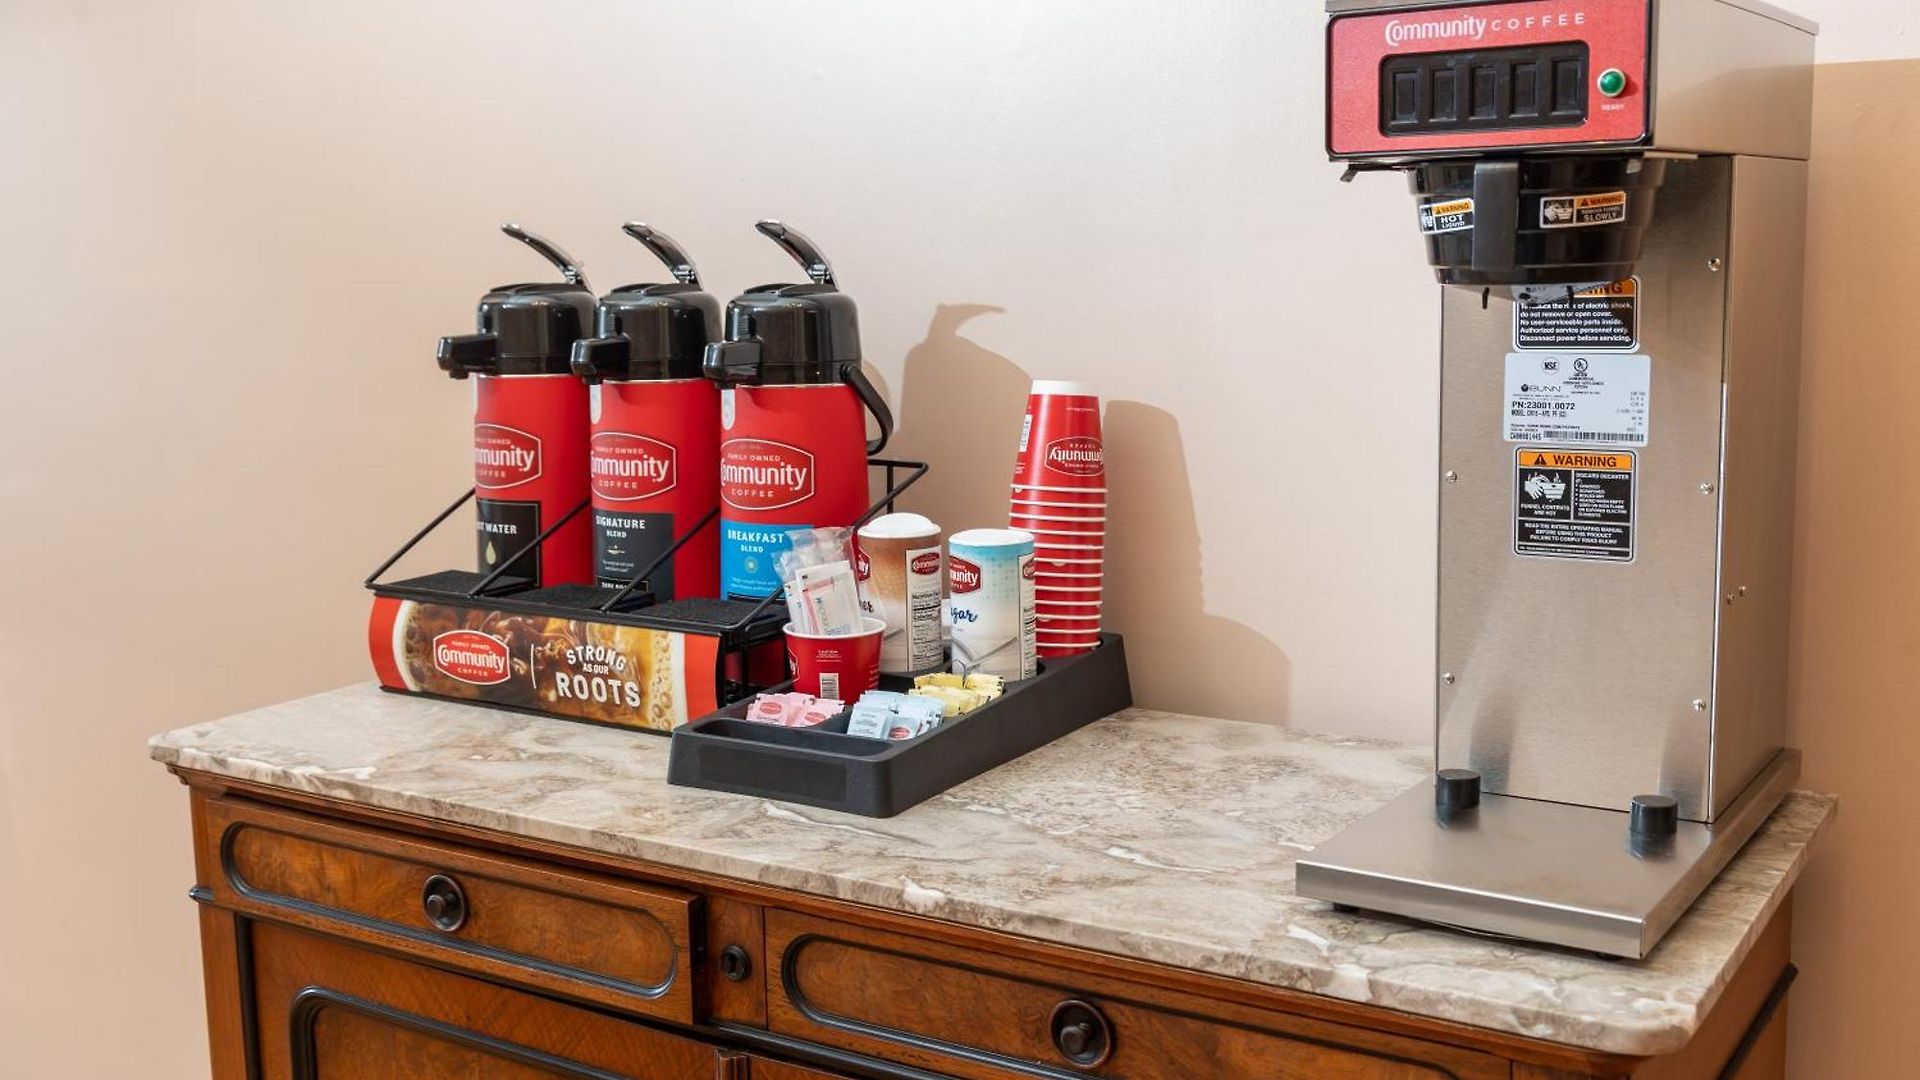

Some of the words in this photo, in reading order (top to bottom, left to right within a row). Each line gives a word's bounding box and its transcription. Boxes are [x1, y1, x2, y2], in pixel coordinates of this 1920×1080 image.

[1384, 15, 1487, 46] Community
[1491, 12, 1585, 32] COFFEE
[1440, 214, 1464, 224] HOT
[1584, 212, 1618, 221] SLOWLY
[1529, 384, 1561, 392] BUNN
[1512, 400, 1576, 410] PN:23001.0072
[1553, 455, 1616, 468] WARNING
[598, 480, 638, 489] COFFEE
[732, 488, 774, 498] COFFEE
[596, 516, 645, 529] SIGNATURE
[486, 522, 517, 535] WATER
[606, 530, 626, 538] BLEND
[728, 529, 784, 543] BREAKFAST
[741, 544, 764, 553] BLEND
[438, 644, 504, 674] Community
[566, 645, 626, 671] STRONG
[457, 668, 488, 676] COFFEE
[582, 663, 593, 673] AS
[593, 664, 608, 675] OUR
[556, 672, 641, 707] ROOTS
